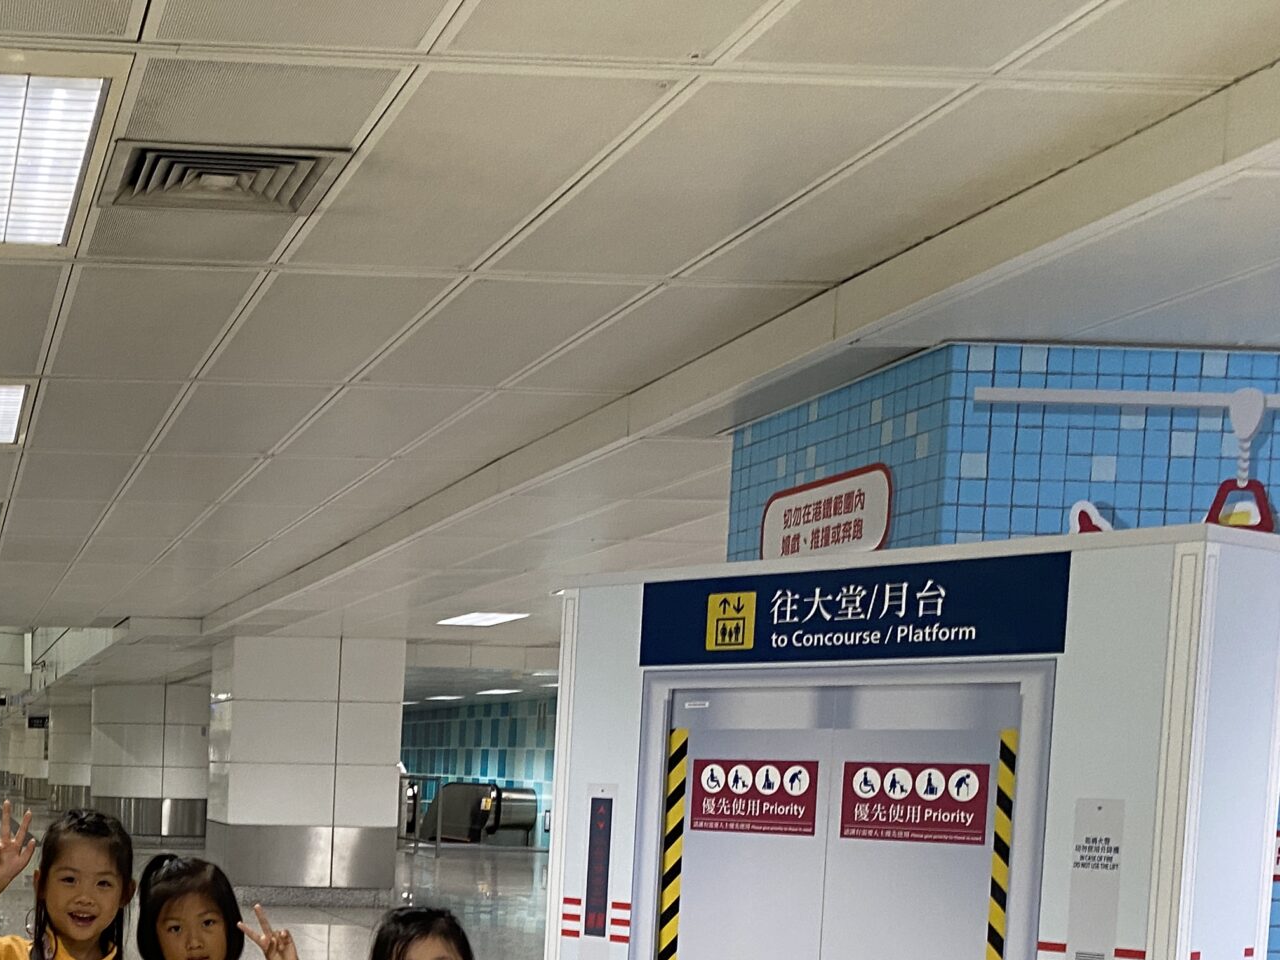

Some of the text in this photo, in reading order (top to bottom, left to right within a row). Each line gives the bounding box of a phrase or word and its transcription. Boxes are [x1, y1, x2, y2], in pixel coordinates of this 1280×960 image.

[783, 488, 865, 530] 切勿在港鐵範圍內
[770, 579, 946, 625] 往大堂/月台
[771, 622, 977, 648] to Concourse / Platform
[702, 797, 806, 818] 優先使用 Priority
[854, 802, 975, 826] 優先使用 Priority
